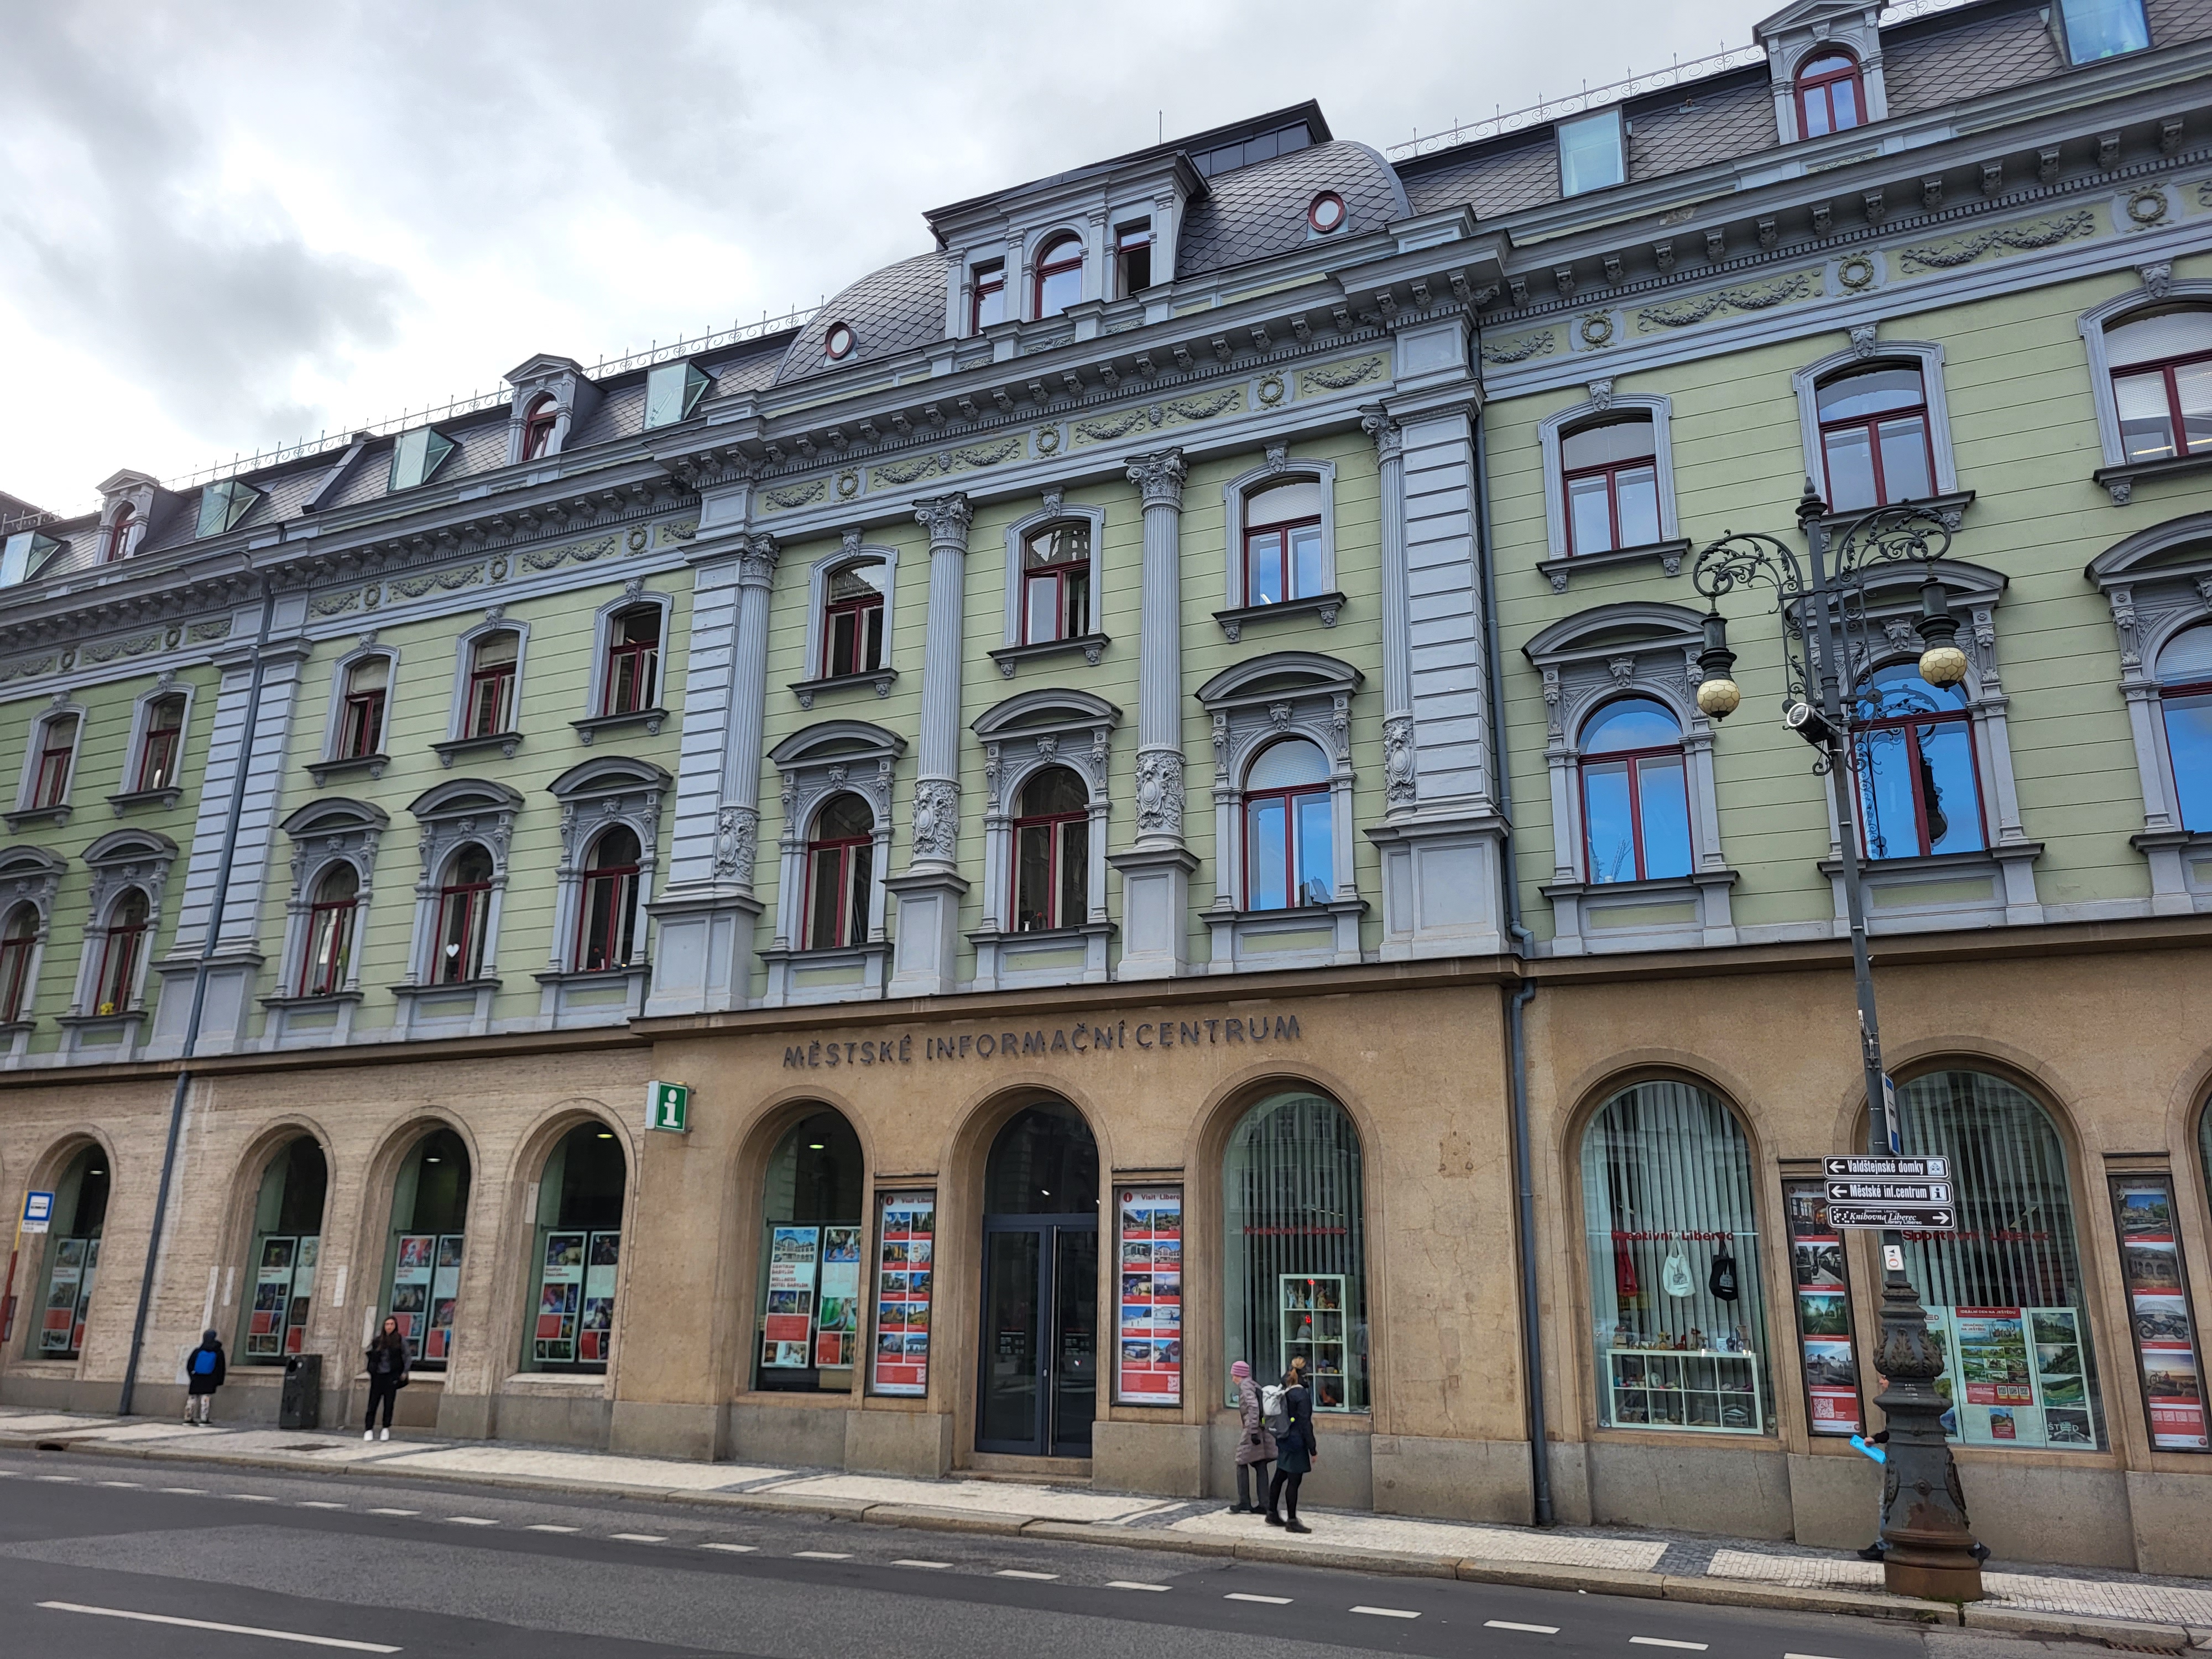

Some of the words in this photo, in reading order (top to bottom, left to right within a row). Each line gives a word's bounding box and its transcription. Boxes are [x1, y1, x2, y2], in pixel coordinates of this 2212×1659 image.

[783, 1034, 911, 1068] MĚSTSKÉ
[926, 1019, 1126, 1061] INFORMAČNÍ
[1135, 1015, 1302, 1049] CENTRUM
[1847, 1160, 1896, 1175] Valdštejnské
[1898, 1160, 1923, 1175] domky
[1849, 1185, 1881, 1197] Městské
[1884, 1185, 1927, 1198] inf.centrum
[1849, 1212, 1886, 1220] Knihovna
[1244, 1225, 1297, 1235] Kreativní
[1302, 1225, 1348, 1235] Liberec
[1611, 1229, 1673, 1240] Keativní
[1902, 1230, 1979, 1243] Sportovní
